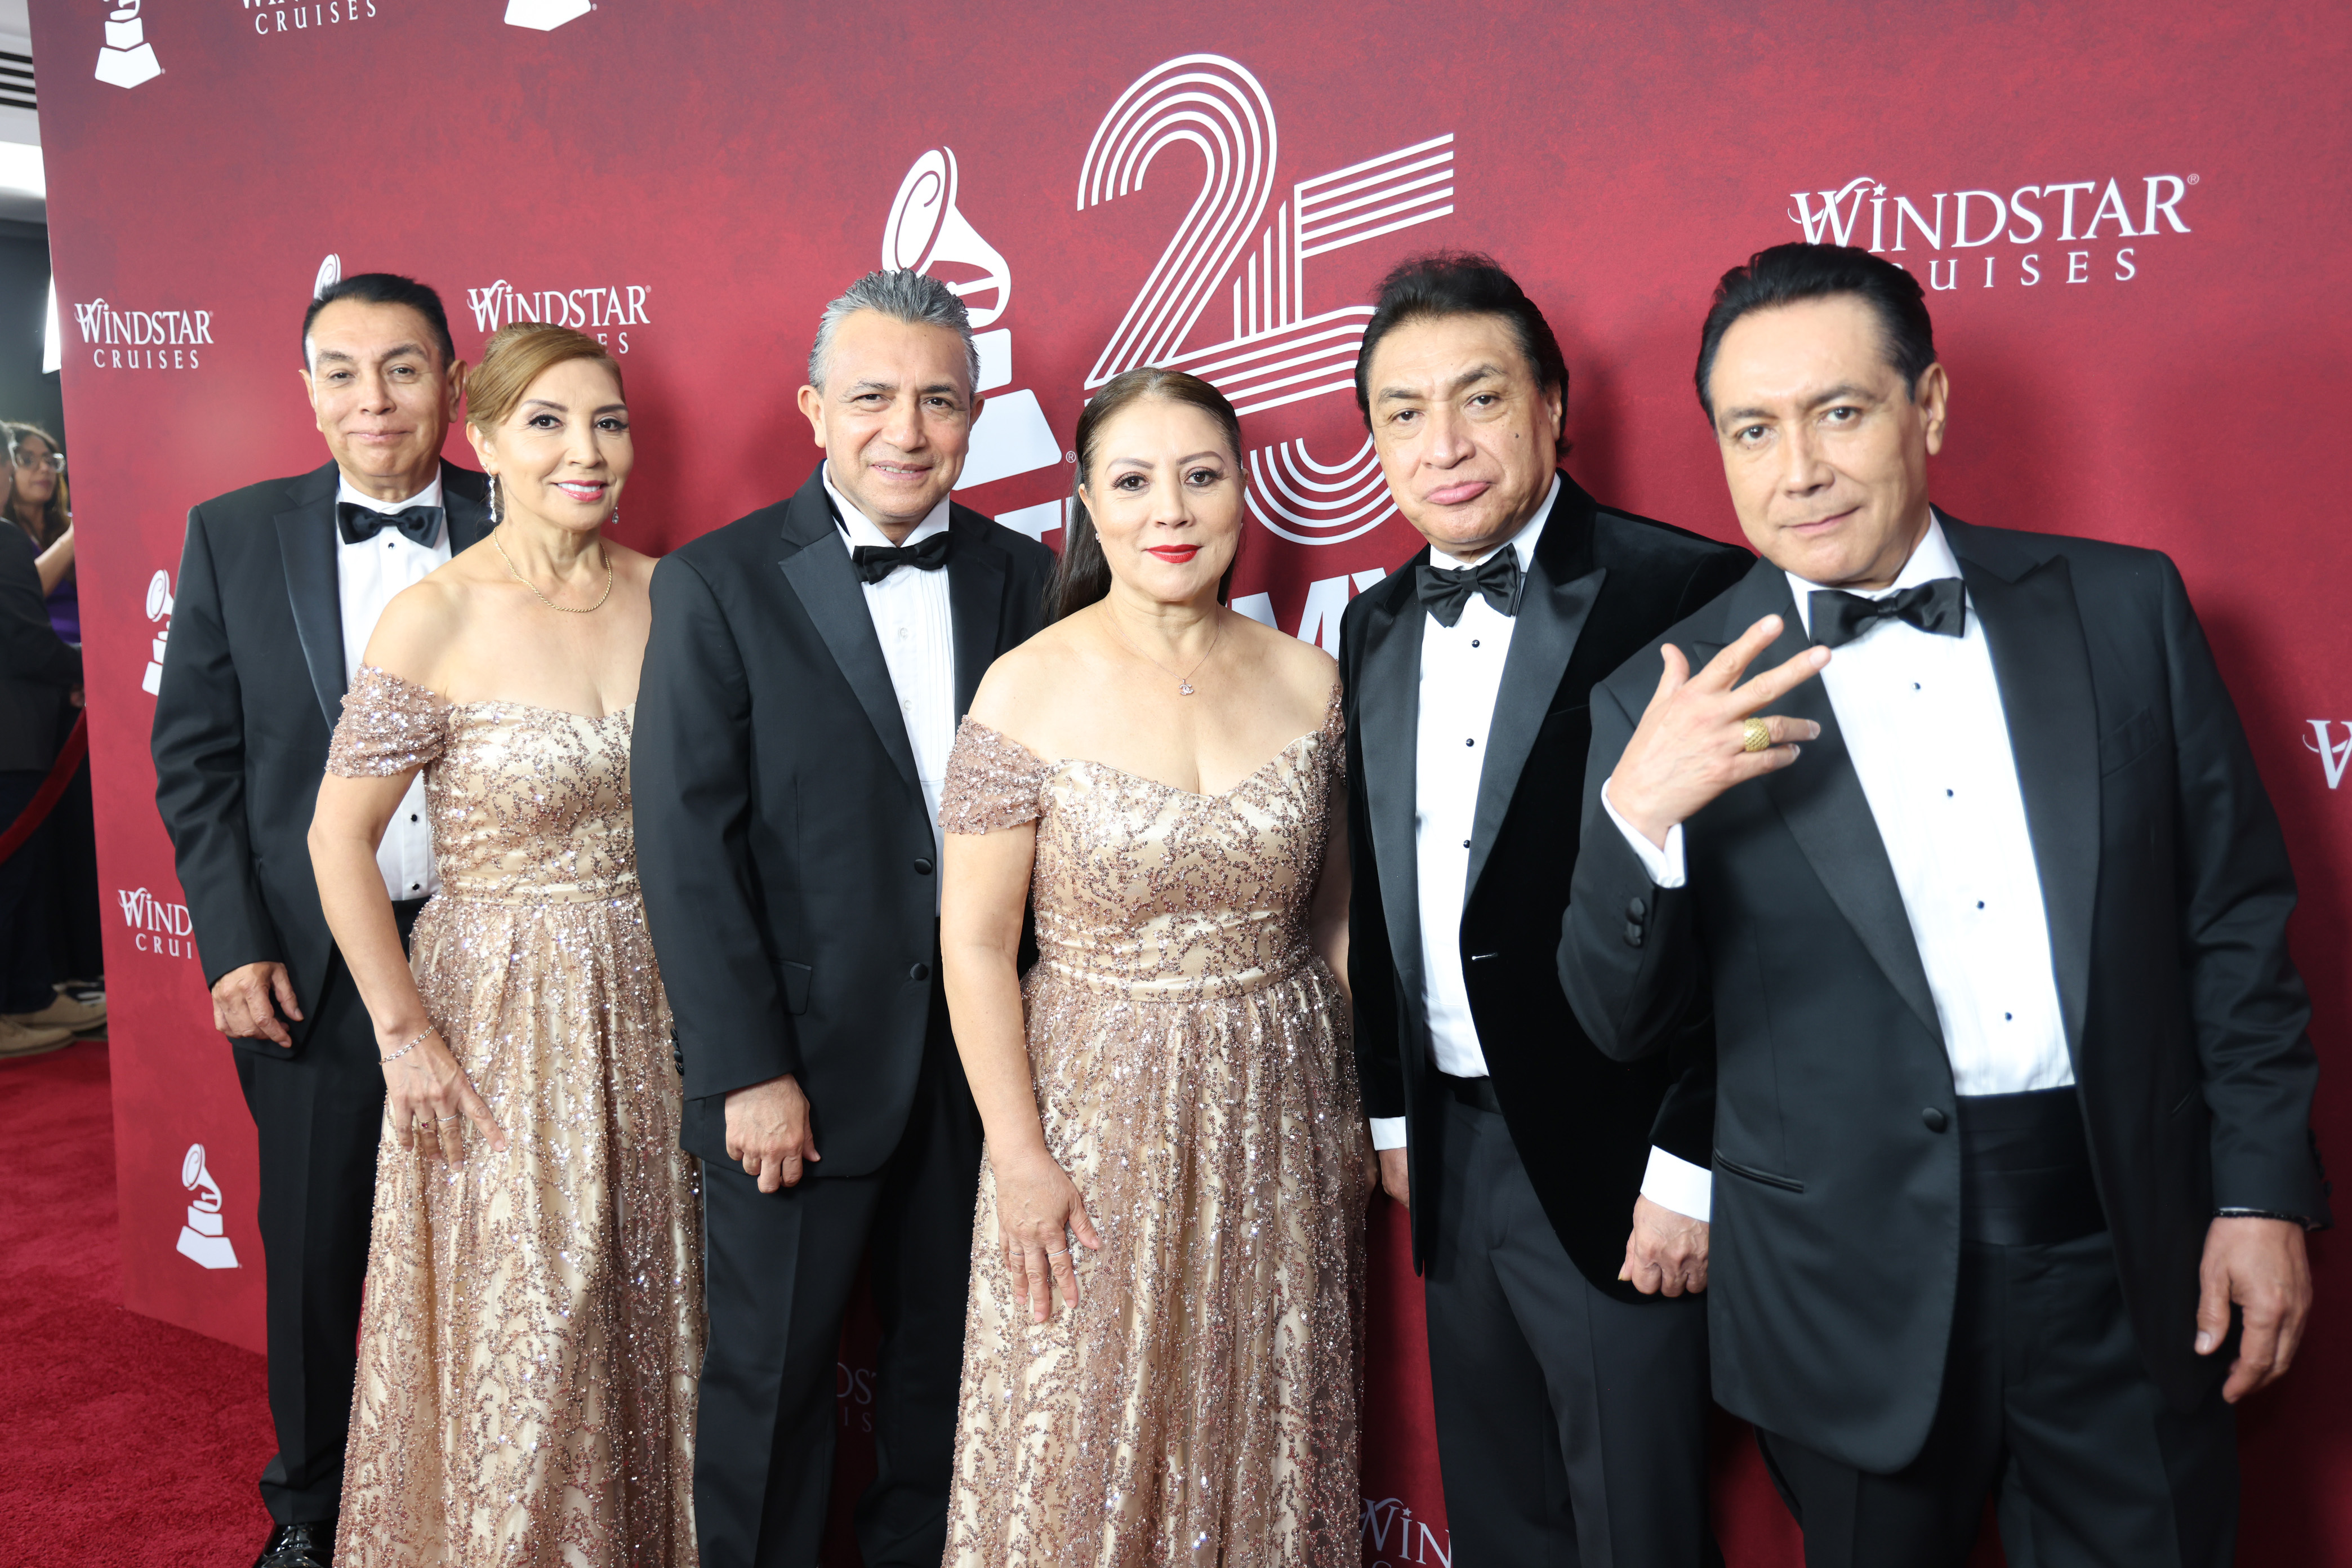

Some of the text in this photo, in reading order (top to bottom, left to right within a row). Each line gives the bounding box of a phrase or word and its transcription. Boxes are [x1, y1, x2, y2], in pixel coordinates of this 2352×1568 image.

[255, 0, 376, 35] CRUISES
[1788, 176, 2191, 253] WINDSTAR
[1891, 248, 2136, 291] UISES
[74, 297, 215, 345] WINDSTAR
[467, 279, 651, 332] WINDSTAR
[1077, 53, 1454, 546] 25
[93, 349, 199, 369] CRUISES
[117, 887, 193, 936] WIND
[135, 933, 192, 959] CRUI
